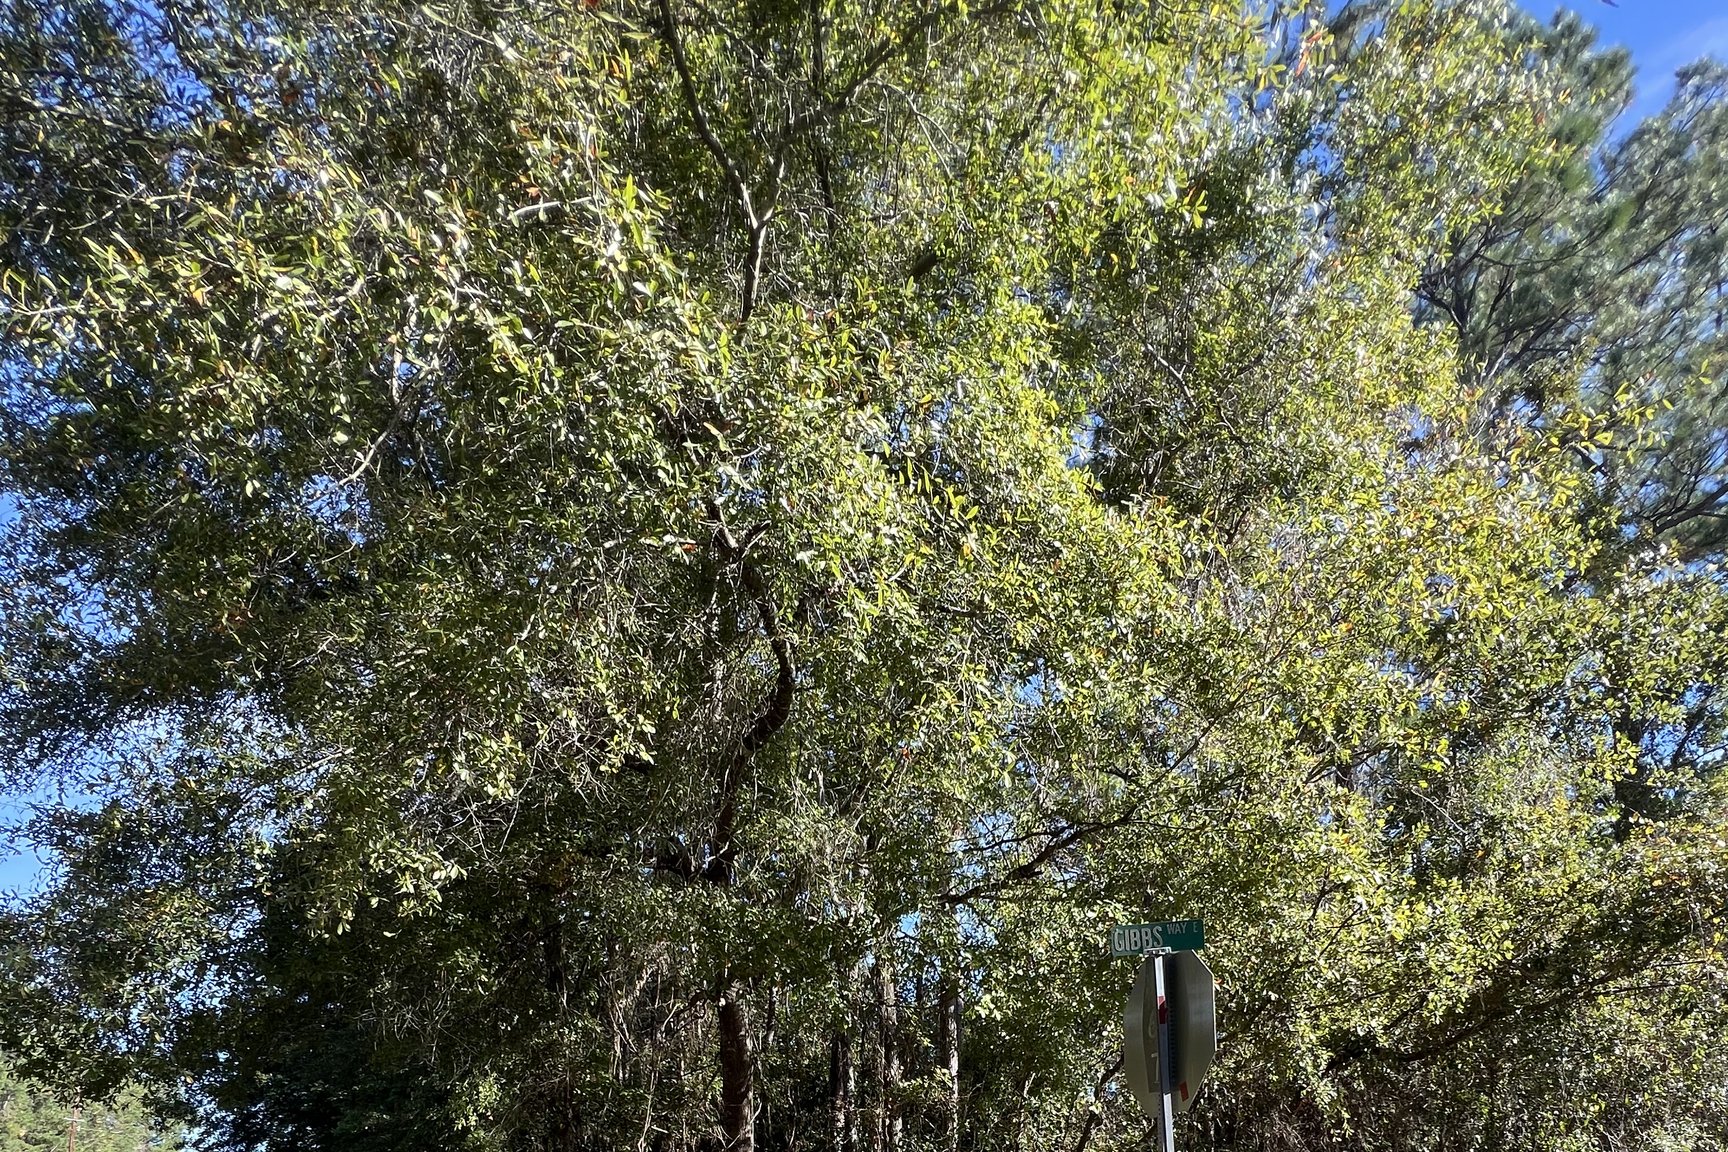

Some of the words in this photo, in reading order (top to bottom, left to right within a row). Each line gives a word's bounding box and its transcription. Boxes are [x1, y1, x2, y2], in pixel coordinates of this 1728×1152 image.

[1114, 926, 1163, 952] GIBBS
[1166, 921, 1187, 935] WAY
[1193, 921, 1198, 933] E
